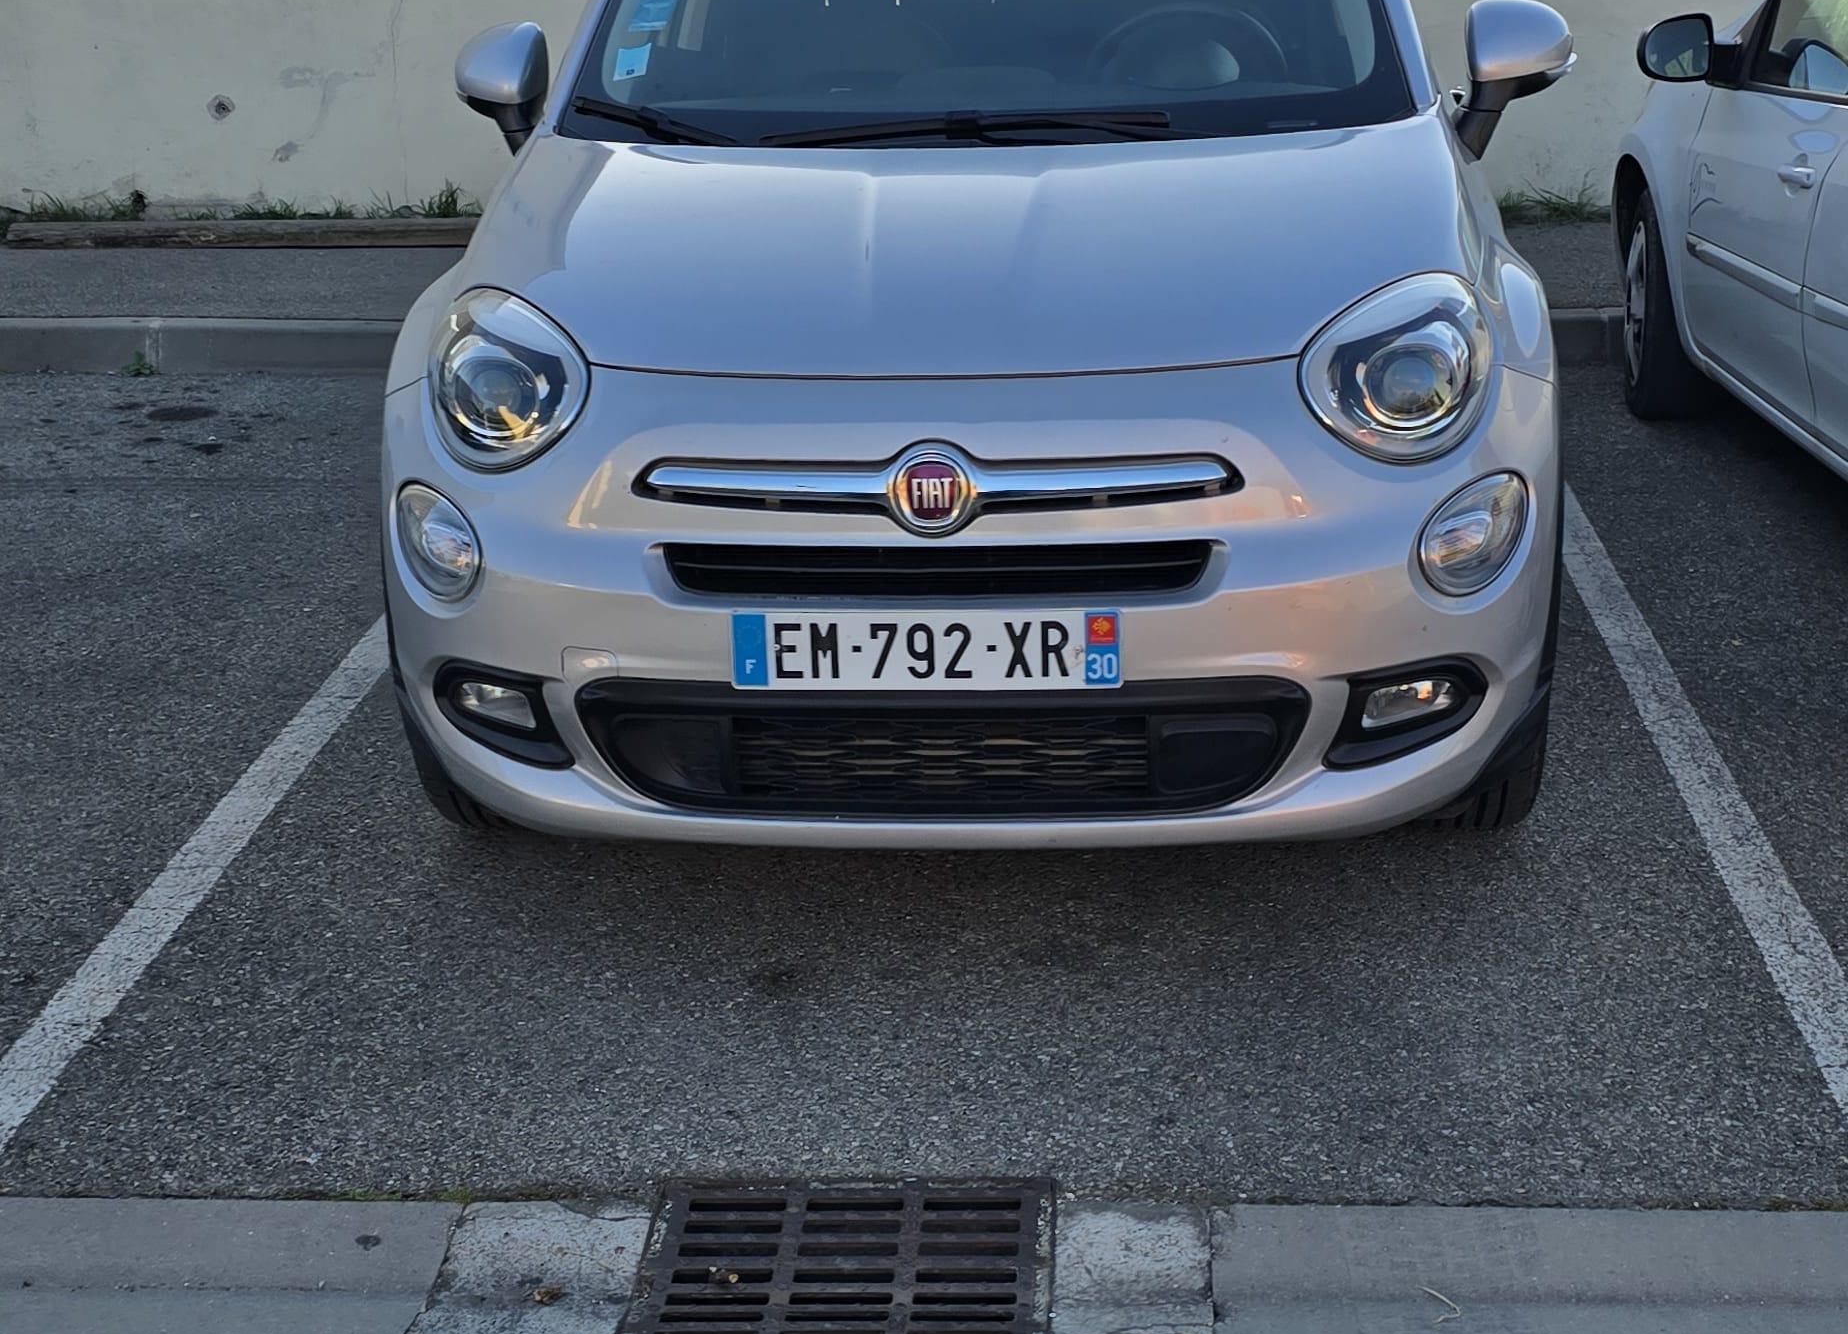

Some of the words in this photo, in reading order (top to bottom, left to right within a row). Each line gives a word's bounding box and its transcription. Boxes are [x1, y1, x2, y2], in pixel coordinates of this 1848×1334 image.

[912, 478, 953, 509] FIAT
[773, 620, 1070, 679] EM-792-XR
[745, 659, 757, 675] F
[1087, 653, 1118, 680] 30
